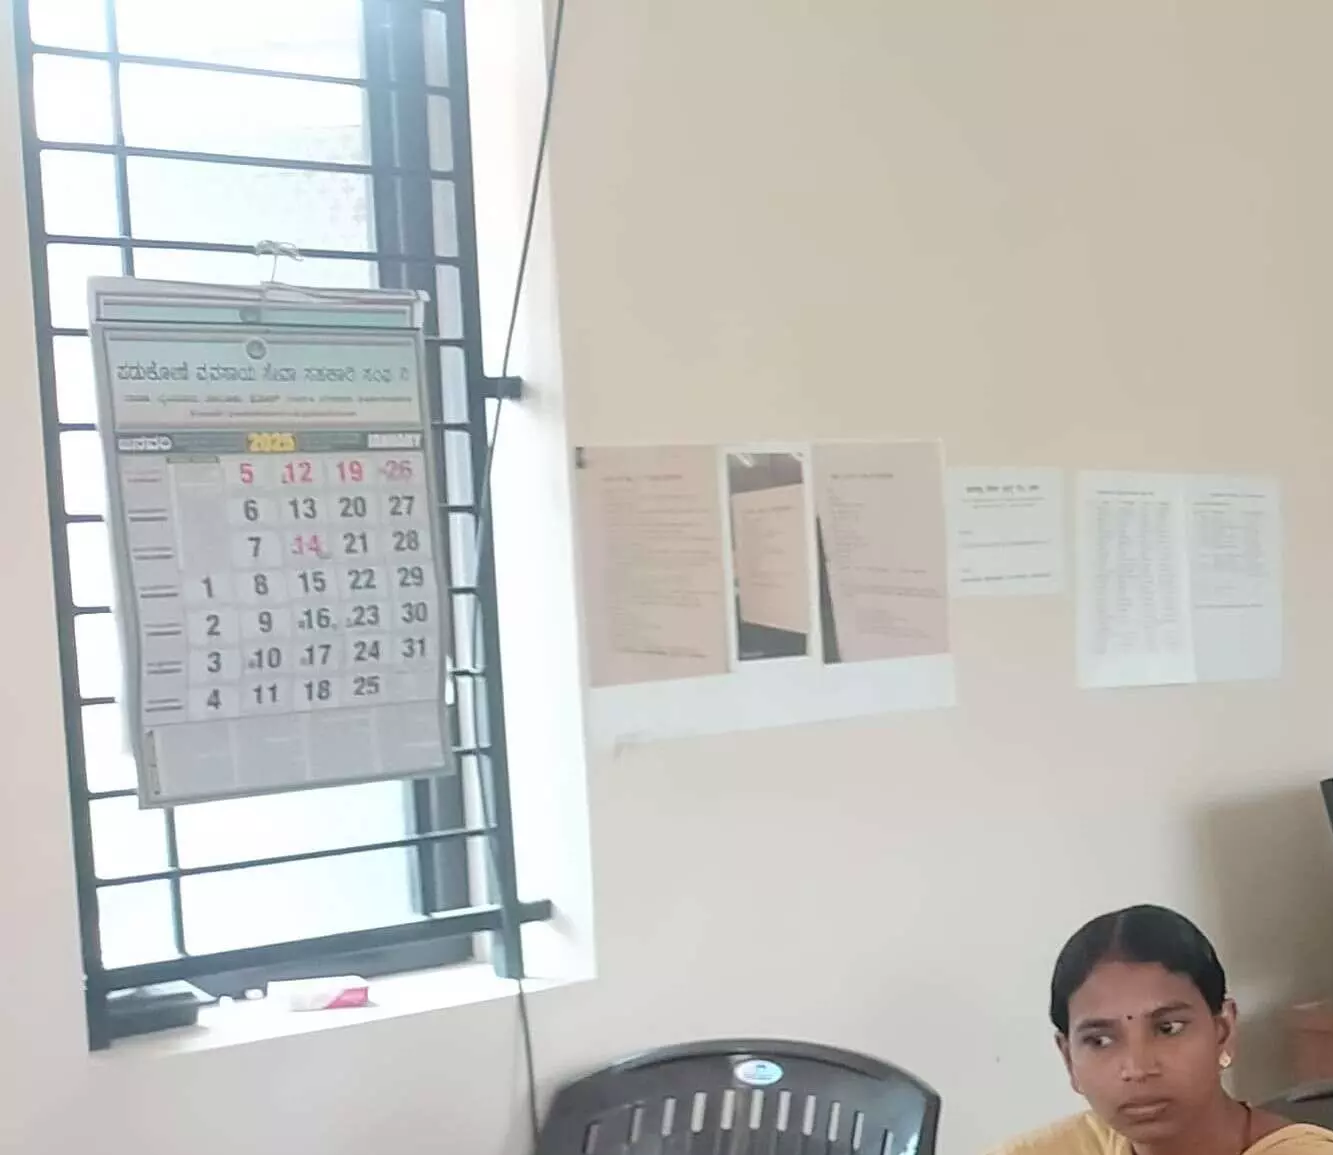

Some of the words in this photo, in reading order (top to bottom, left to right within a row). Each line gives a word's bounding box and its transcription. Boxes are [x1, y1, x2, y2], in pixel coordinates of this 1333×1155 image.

[239, 463, 254, 484] 5
[285, 461, 313, 484] 12
[337, 460, 364, 483] 19
[244, 500, 258, 521] 6
[289, 498, 317, 520] 13
[340, 497, 367, 518] 20
[389, 496, 415, 516] 27
[248, 537, 262, 558] 7
[343, 533, 368, 554] 21
[392, 530, 419, 551] 28
[202, 577, 214, 598] 1
[254, 574, 269, 595] 8
[299, 571, 326, 593] 15
[348, 569, 376, 590] 22
[397, 567, 424, 587] 29
[206, 614, 220, 636] 2
[258, 611, 272, 633] 9
[303, 608, 331, 630] 16
[353, 605, 380, 626] 23
[401, 602, 428, 623] 30
[207, 652, 221, 673] 3
[253, 648, 281, 669] 10
[305, 644, 332, 665] 17
[353, 641, 380, 661] 24
[401, 638, 426, 658] 31
[206, 689, 222, 710] 4
[253, 684, 279, 703] 11
[304, 680, 331, 701] 18
[353, 675, 380, 696] 25
